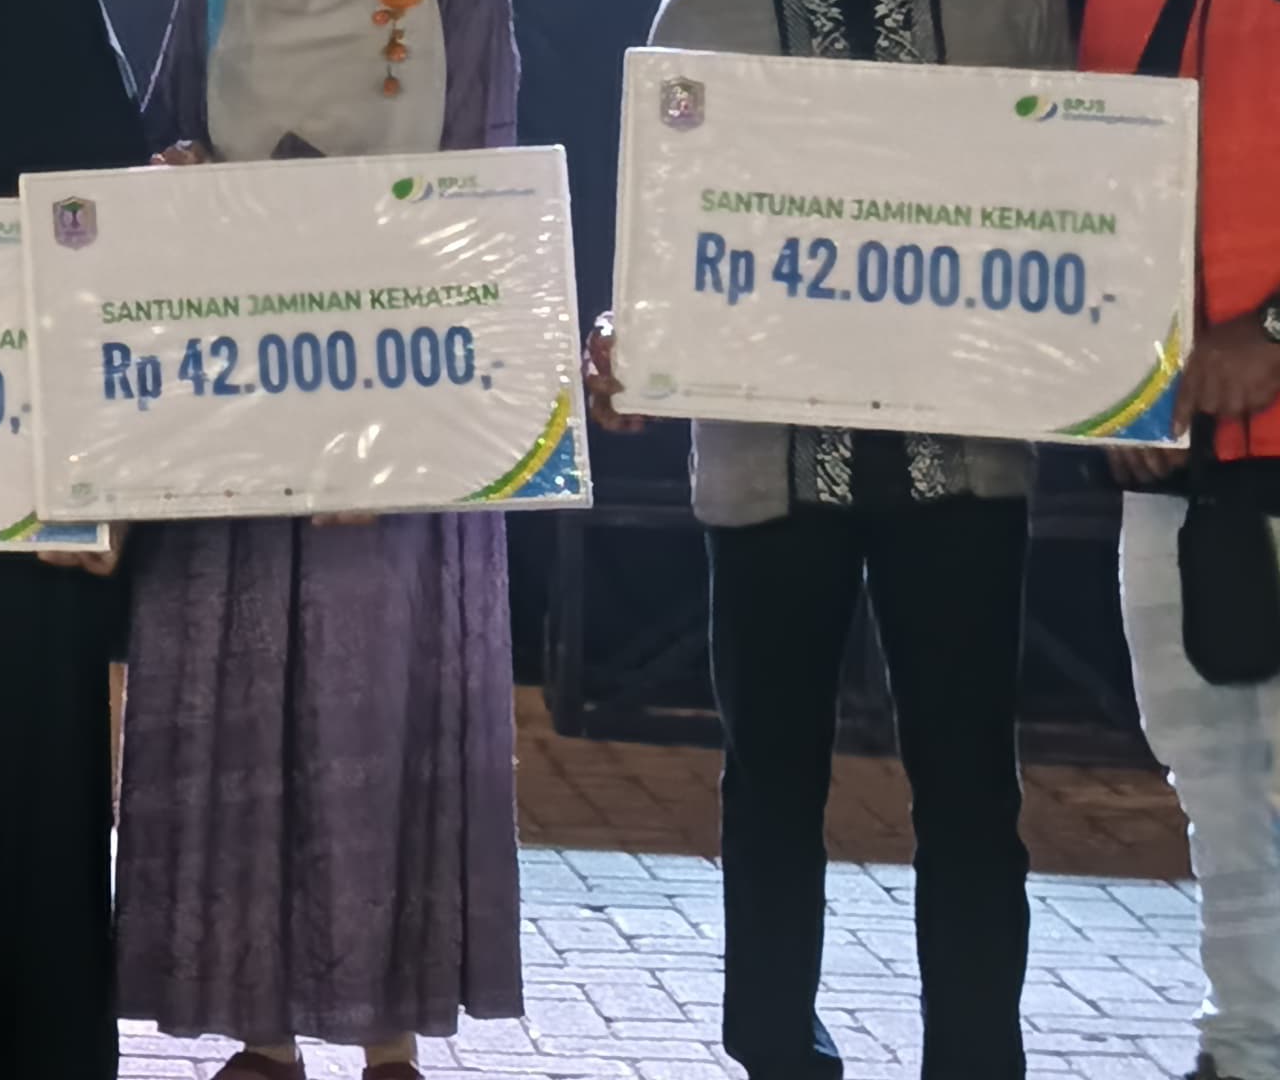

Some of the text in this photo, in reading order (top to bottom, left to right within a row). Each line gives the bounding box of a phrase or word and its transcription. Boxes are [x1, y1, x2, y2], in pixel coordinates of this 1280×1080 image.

[701, 189, 1117, 236] SANTUNAN JAMINAN KEMATIAN
[102, 282, 500, 324] SANTUNAN JAMINAN KEMATIAN
[694, 231, 1117, 324] Rp 42.000.000,-
[101, 341, 163, 411] Rp
